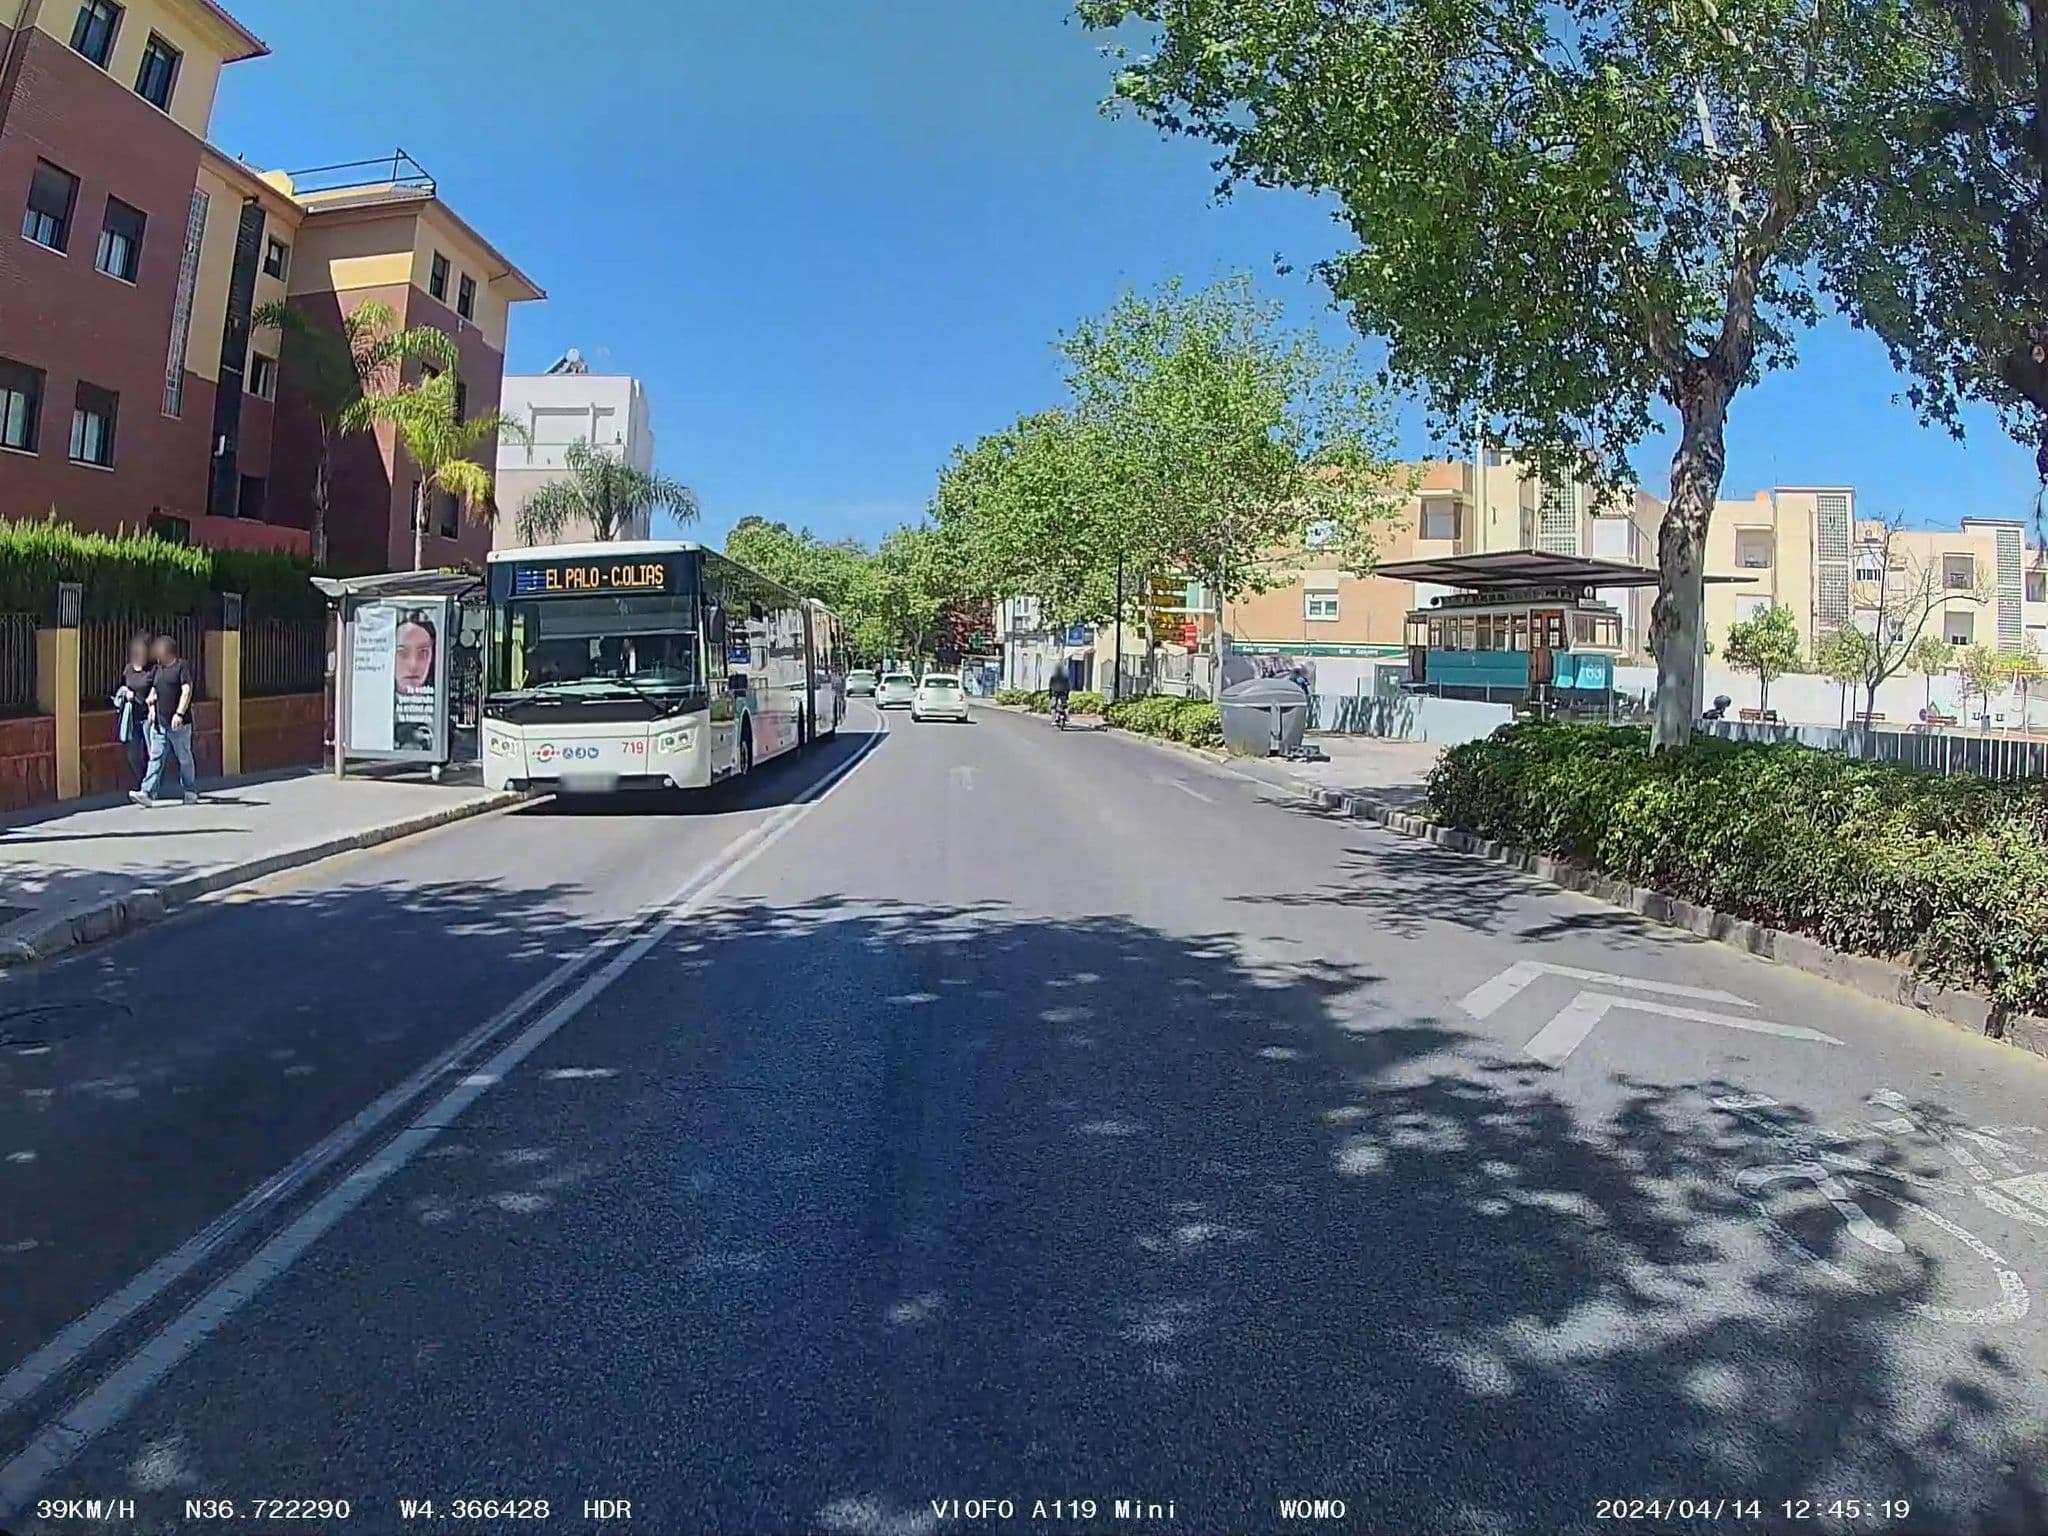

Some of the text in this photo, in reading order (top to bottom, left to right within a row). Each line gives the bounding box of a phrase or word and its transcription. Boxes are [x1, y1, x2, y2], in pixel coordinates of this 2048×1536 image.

[545, 568, 563, 590] EL
[565, 566, 600, 589] PALO
[621, 740, 645, 755] 719
